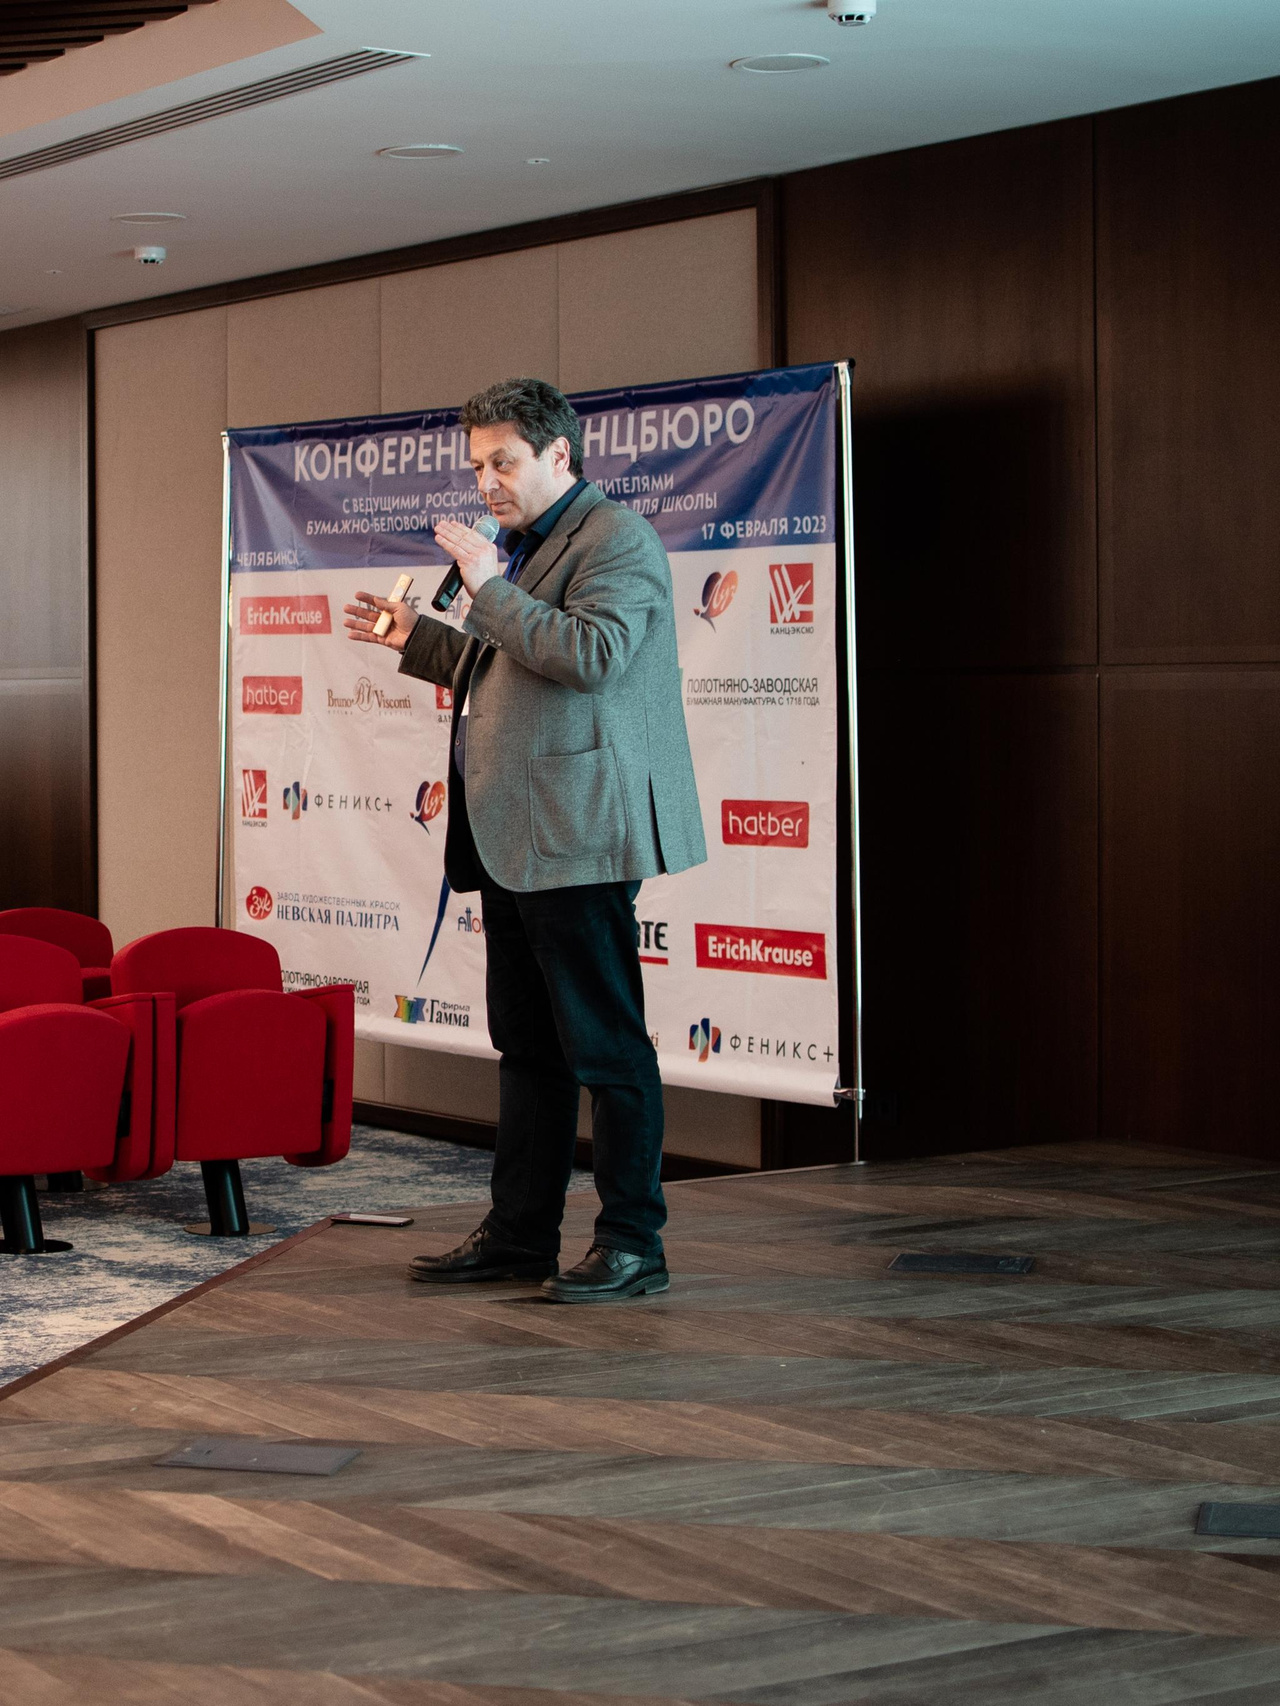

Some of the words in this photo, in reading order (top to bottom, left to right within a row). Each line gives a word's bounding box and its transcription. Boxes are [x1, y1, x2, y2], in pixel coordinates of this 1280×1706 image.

[294, 431, 472, 482] КОНФЕРЕНЦ
[584, 400, 755, 462] НЦБЮРО
[342, 498, 350, 514] С
[353, 494, 419, 515] ВЕДУЩИМИ
[426, 485, 486, 509] РОССИЙС
[306, 510, 428, 536] БУМАЖНО-БЕЛОВОЙ
[661, 492, 718, 513] ШКОЛЫ
[701, 522, 715, 540] 17
[720, 517, 788, 540] ФЕВРАЛЯ
[793, 515, 827, 535] 2023
[236, 549, 299, 567] ЧЕЛЯБИНСК
[247, 606, 323, 625] ErichKrause
[247, 685, 297, 706] hatber
[327, 688, 352, 708] Bruno
[374, 689, 412, 709] Visconti
[686, 677, 818, 696] ПОЛОТНЯНО-ЗАВОДСКАЯ
[724, 696, 776, 706] МАНУФАКТУРА
[803, 696, 820, 707] ГОДА
[729, 810, 803, 837] hatber
[277, 891, 300, 903] ЗАВОД
[302, 894, 366, 907] ХУДОЖЕСТВЕННЫХ
[370, 900, 400, 911] КРАСОК
[277, 904, 331, 925] НЕВСКАЯ
[336, 910, 399, 931] ПАЛИТРА
[708, 935, 813, 967] ErichKrause
[429, 999, 469, 1027] Гамма
